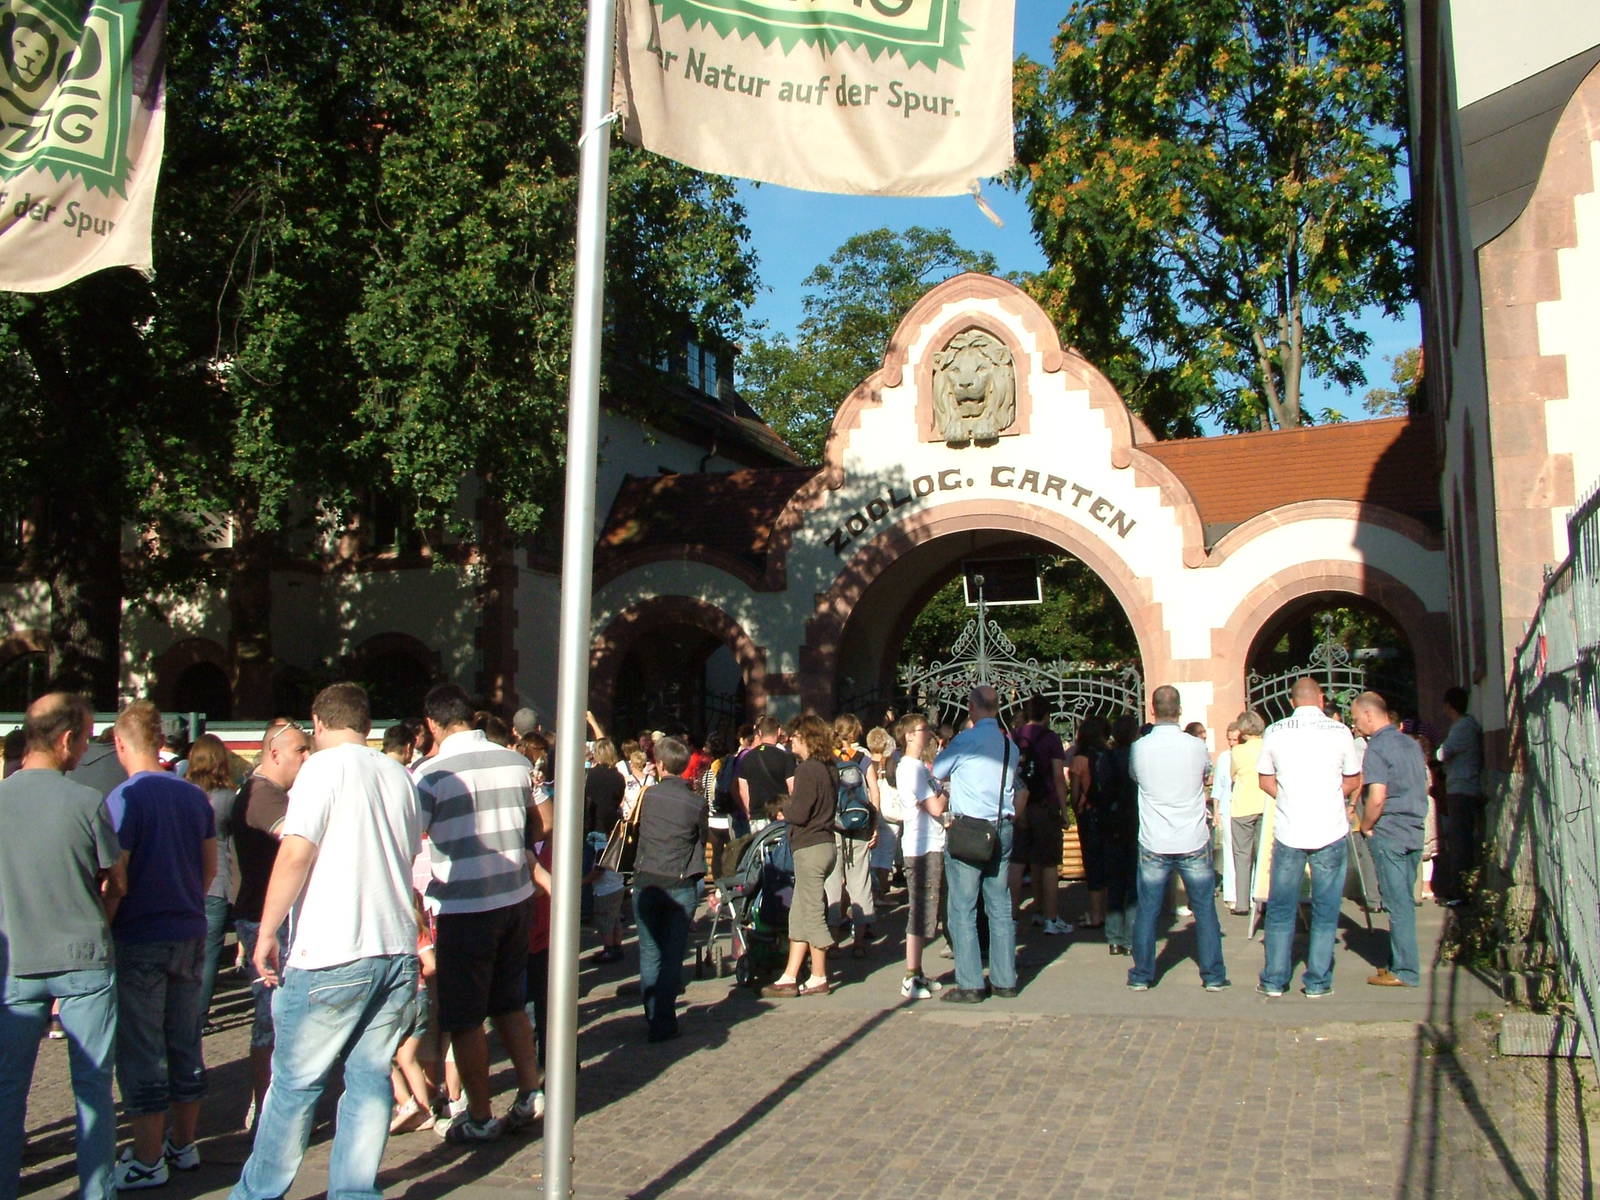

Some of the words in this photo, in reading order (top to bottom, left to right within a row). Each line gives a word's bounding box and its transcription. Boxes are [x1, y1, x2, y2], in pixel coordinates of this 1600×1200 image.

[685, 48, 770, 97] Natur
[778, 75, 830, 105] auf
[836, 74, 878, 107] der
[887, 80, 961, 118] Spur.
[14, 193, 56, 222] der
[824, 468, 974, 556] ZOOLOG.
[990, 466, 1136, 539] GARTEN
